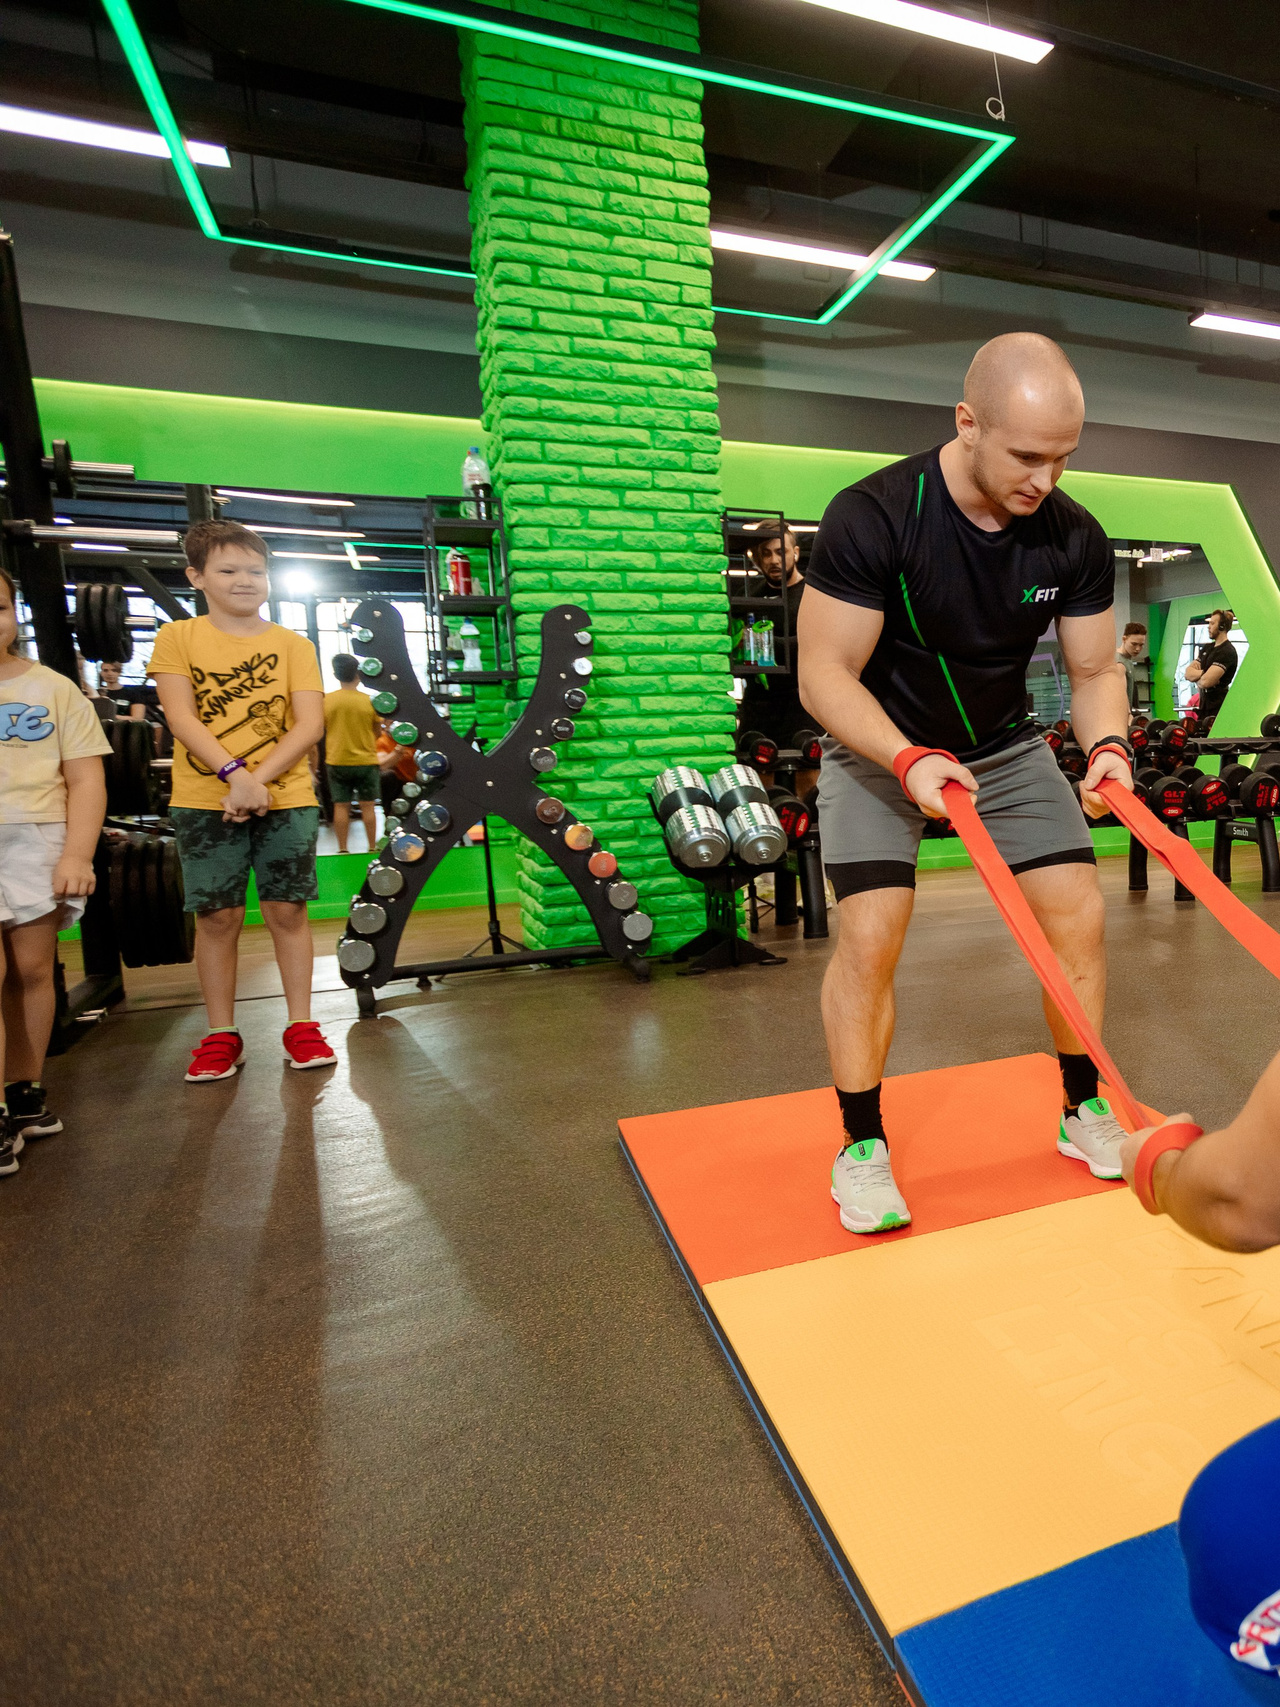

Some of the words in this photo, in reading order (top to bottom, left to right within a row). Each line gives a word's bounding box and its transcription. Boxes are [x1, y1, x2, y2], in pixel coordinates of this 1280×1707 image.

[1020, 584, 1060, 603] XFIT
[1163, 790, 1187, 798] GLT
[1232, 826, 1249, 837] Smith
